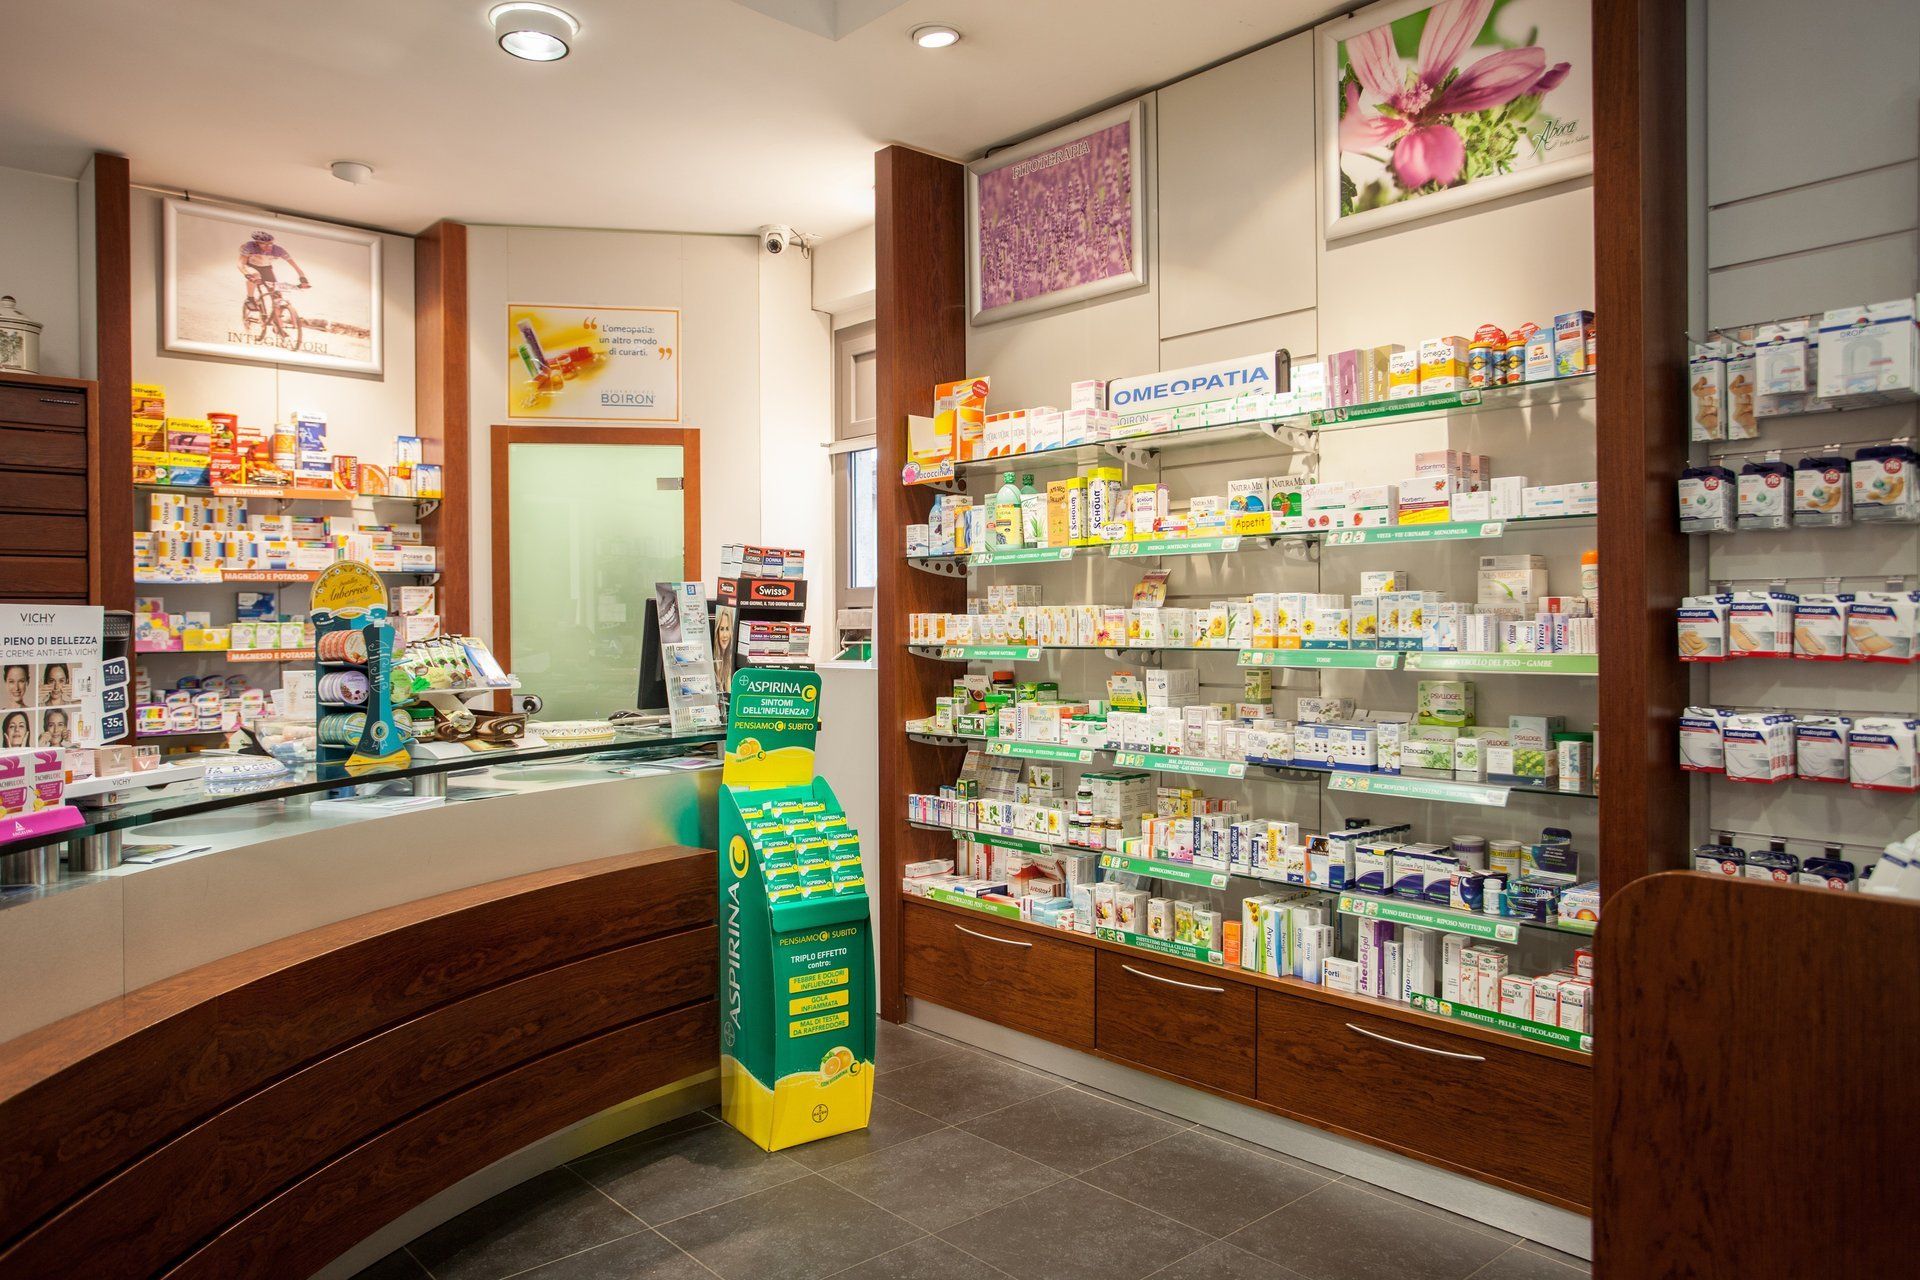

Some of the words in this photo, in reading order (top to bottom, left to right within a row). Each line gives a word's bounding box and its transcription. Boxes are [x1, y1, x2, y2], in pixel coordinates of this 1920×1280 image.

[1012, 140, 1090, 179] FITOTERAPIA
[602, 324, 655, 334] L'omeopatia:
[226, 329, 329, 355] INTEGRATORI
[599, 336, 609, 344] un
[612, 336, 632, 344] altro
[609, 348, 617, 356] di
[1114, 366, 1269, 406] OMEOPATIA
[601, 394, 655, 404] BOIRON
[1118, 414, 1149, 426] OIRON
[1886, 461, 1900, 471] PIC
[1767, 476, 1780, 485] PIC
[1826, 473, 1838, 482] PIC
[1231, 483, 1250, 492] NATURA
[1272, 479, 1293, 488] NATURA
[1706, 479, 1718, 488] PIC
[1236, 517, 1265, 529] Appetit
[225, 573, 265, 581] MAGNESIO
[273, 573, 309, 581] POTASSIO
[721, 583, 734, 593] Swisse
[759, 585, 787, 596] Swisse
[1732, 602, 1764, 611] Leukoplast
[1798, 606, 1832, 614] Leukoplast
[1853, 605, 1888, 614] Leukoplast
[20, 612, 56, 624] VICHY
[1680, 610, 1710, 618] Leukoplast
[4, 637, 35, 646] PIENO
[38, 637, 48, 645] DI
[50, 636, 98, 645] BELLEZZA
[1537, 623, 1546, 652] Ymea
[1555, 623, 1563, 652] Ymea
[6, 649, 34, 657] CREME
[76, 648, 98, 656] VICHY
[232, 652, 271, 660] MAGNESIO
[279, 651, 315, 659] POTASSIO
[1488, 659, 1501, 667] DEL
[1503, 659, 1520, 667] PESO
[747, 680, 801, 694] ASPIRINA
[804, 687, 813, 700] C
[760, 698, 793, 707] SINTOMI
[743, 705, 809, 716] DELL'INFLUENZA?
[788, 722, 814, 731] SUBITO
[1403, 746, 1434, 756] Finocarbo
[112, 778, 131, 786] VICHY
[1724, 863, 1735, 873] PIC
[1774, 872, 1787, 882] PIC
[1830, 879, 1844, 890] PIC
[1382, 908, 1398, 916] TONO
[1398, 909, 1433, 923] DELL'UMORE
[1437, 917, 1457, 927] RIPOSO
[1457, 920, 1492, 933] NOTTURNO
[832, 927, 857, 938] SUBITO
[729, 881, 741, 1031] ASPIRINA
[791, 952, 816, 964] TRIPLO
[817, 947, 847, 960] EFFETTO
[807, 960, 831, 970] contro:
[793, 974, 817, 984] FEBBRE
[823, 969, 845, 980] DOLORI
[800, 978, 839, 990] INFLUENZALI
[811, 995, 829, 1004] GOLA
[801, 1000, 838, 1012] INFIAMMATA
[800, 1018, 814, 1027] MAL
[815, 1017, 821, 1025] DI
[821, 1014, 840, 1024] TESTA
[793, 1028, 802, 1036] DA
[803, 1019, 846, 1034] RAFFREDDORE
[1460, 1010, 1495, 1024] DERMATITE
[1498, 1017, 1517, 1029] PELLE
[1520, 1024, 1570, 1043] ARTICOLAZIONI
